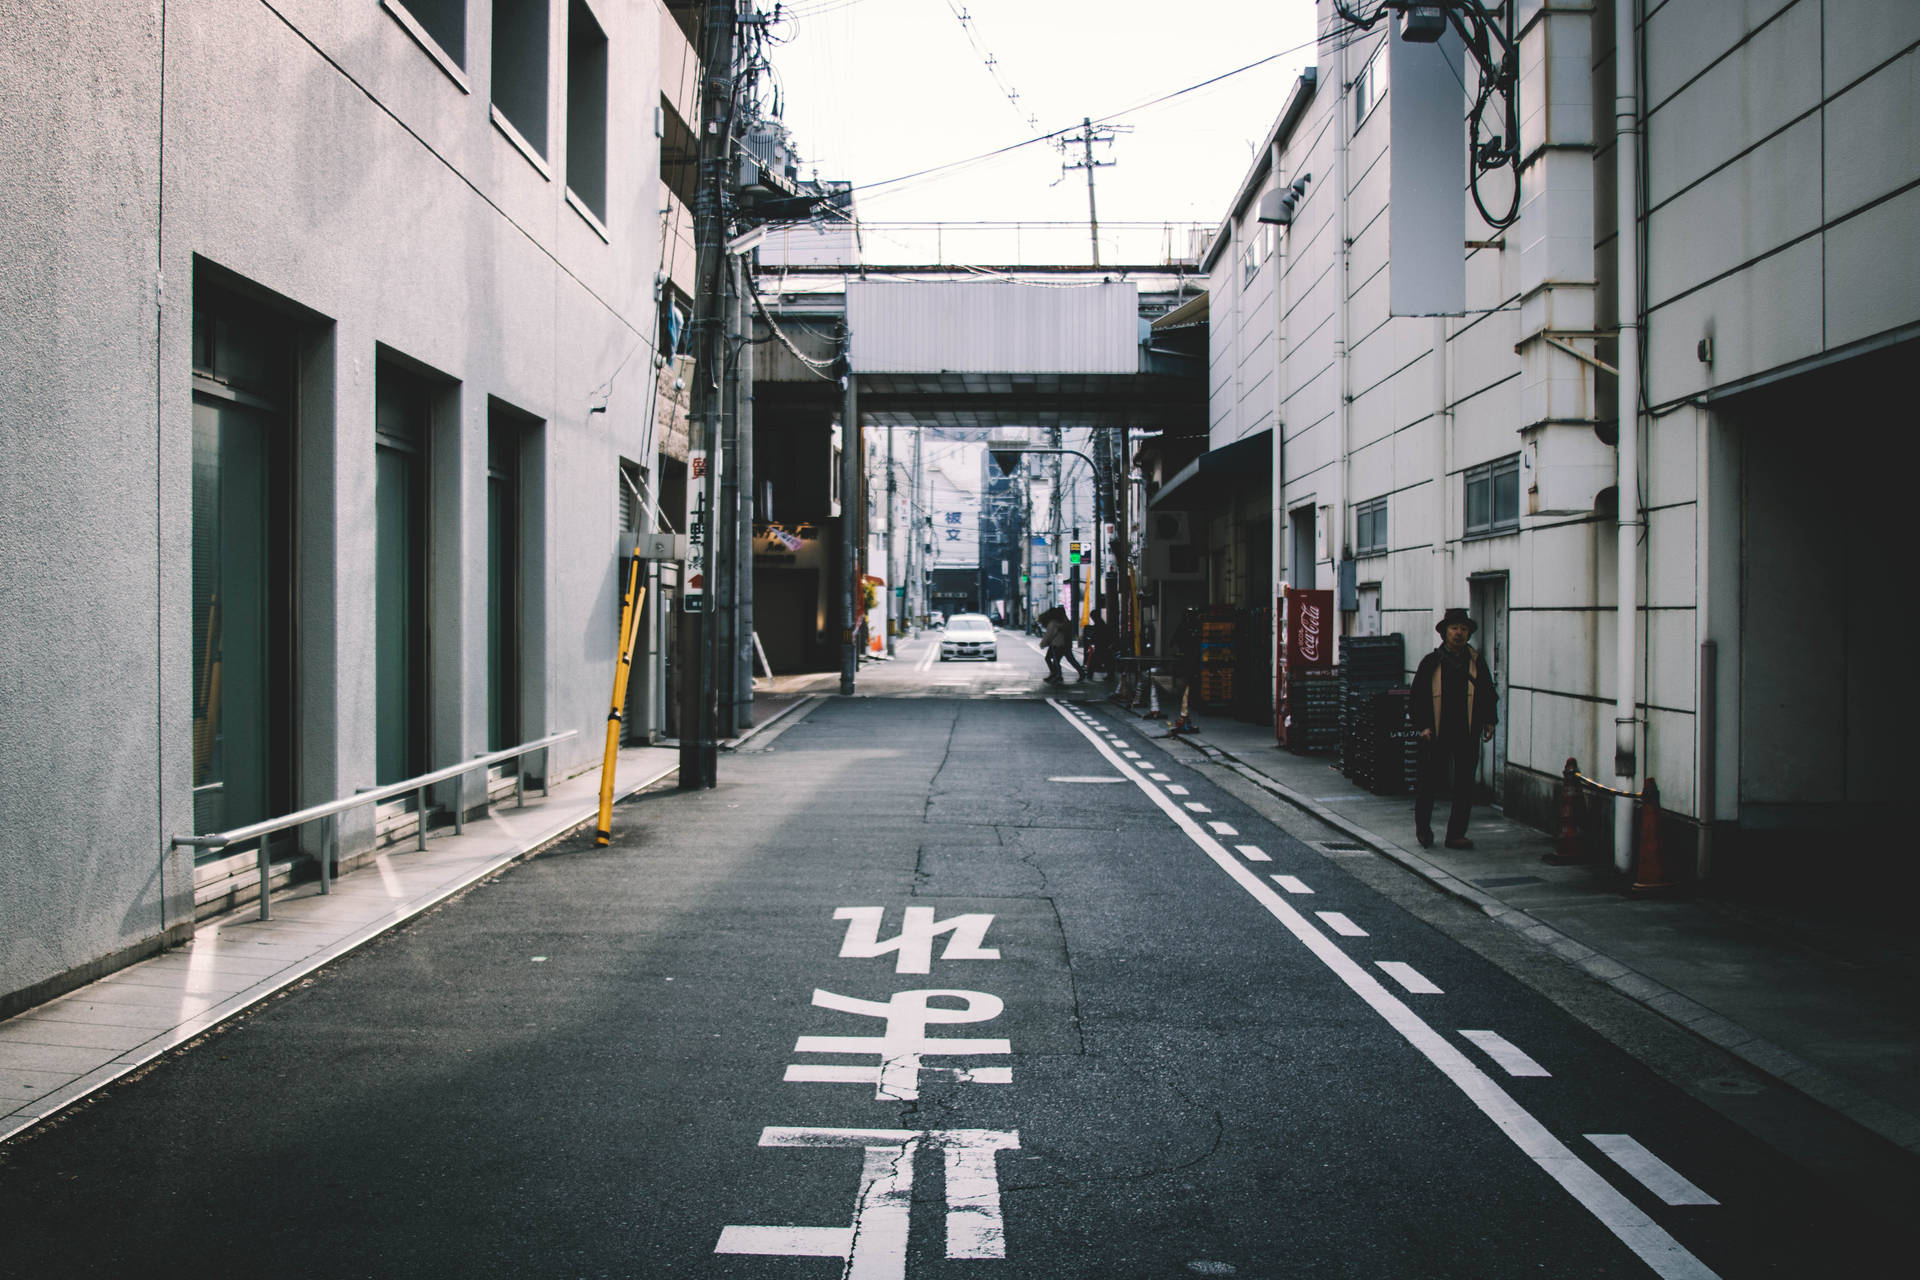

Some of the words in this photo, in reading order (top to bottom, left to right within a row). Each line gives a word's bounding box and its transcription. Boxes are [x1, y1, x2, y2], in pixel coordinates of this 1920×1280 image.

[1080, 543, 1092, 557] P
[713, 906, 1021, 1280] 止まれ
